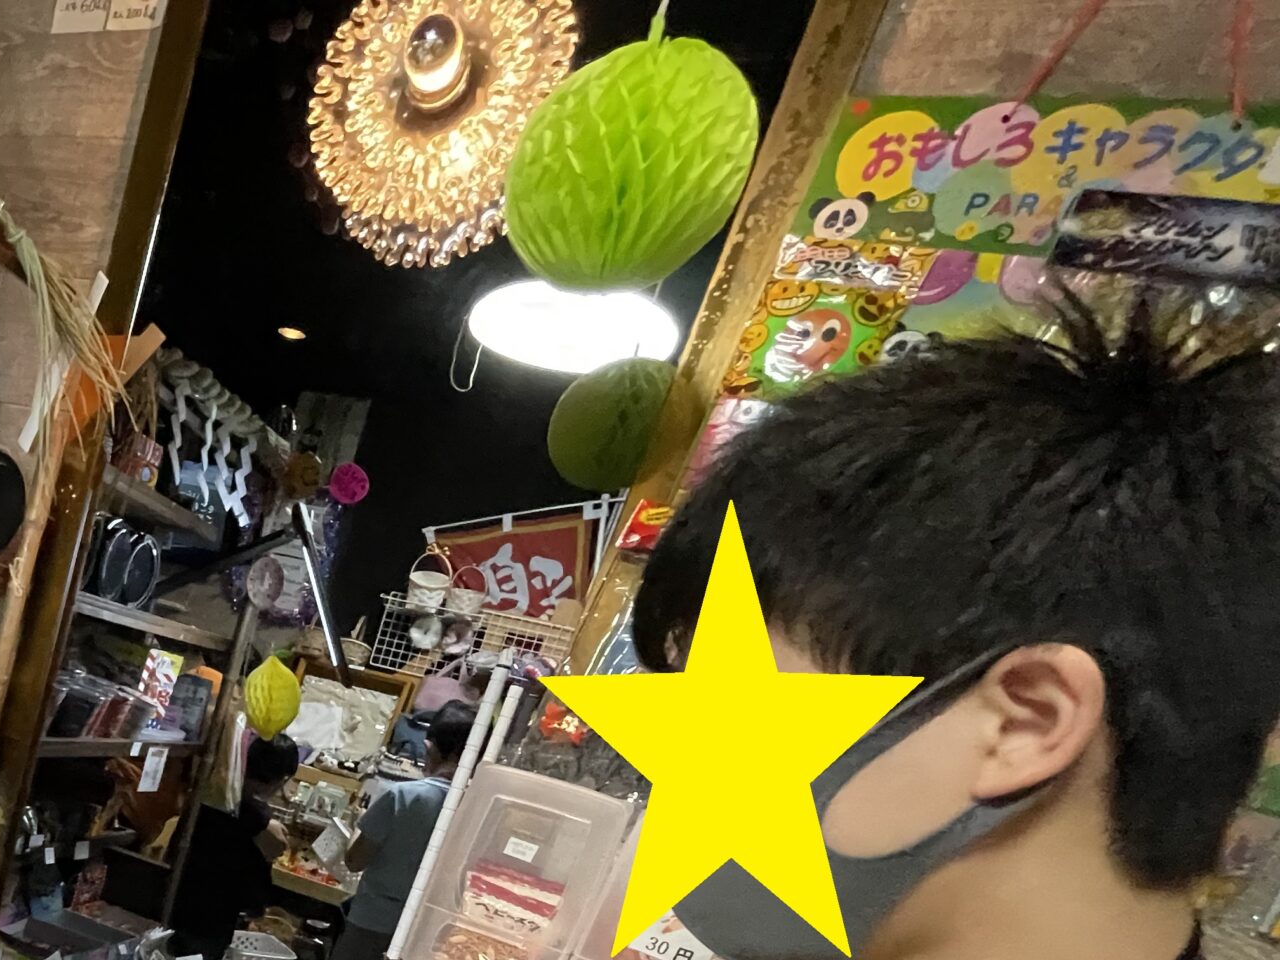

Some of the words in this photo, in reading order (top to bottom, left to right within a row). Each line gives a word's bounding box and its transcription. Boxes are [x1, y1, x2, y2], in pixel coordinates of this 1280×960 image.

[861, 121, 1034, 182] おもしろ
[1044, 118, 1267, 182] キャラクタ
